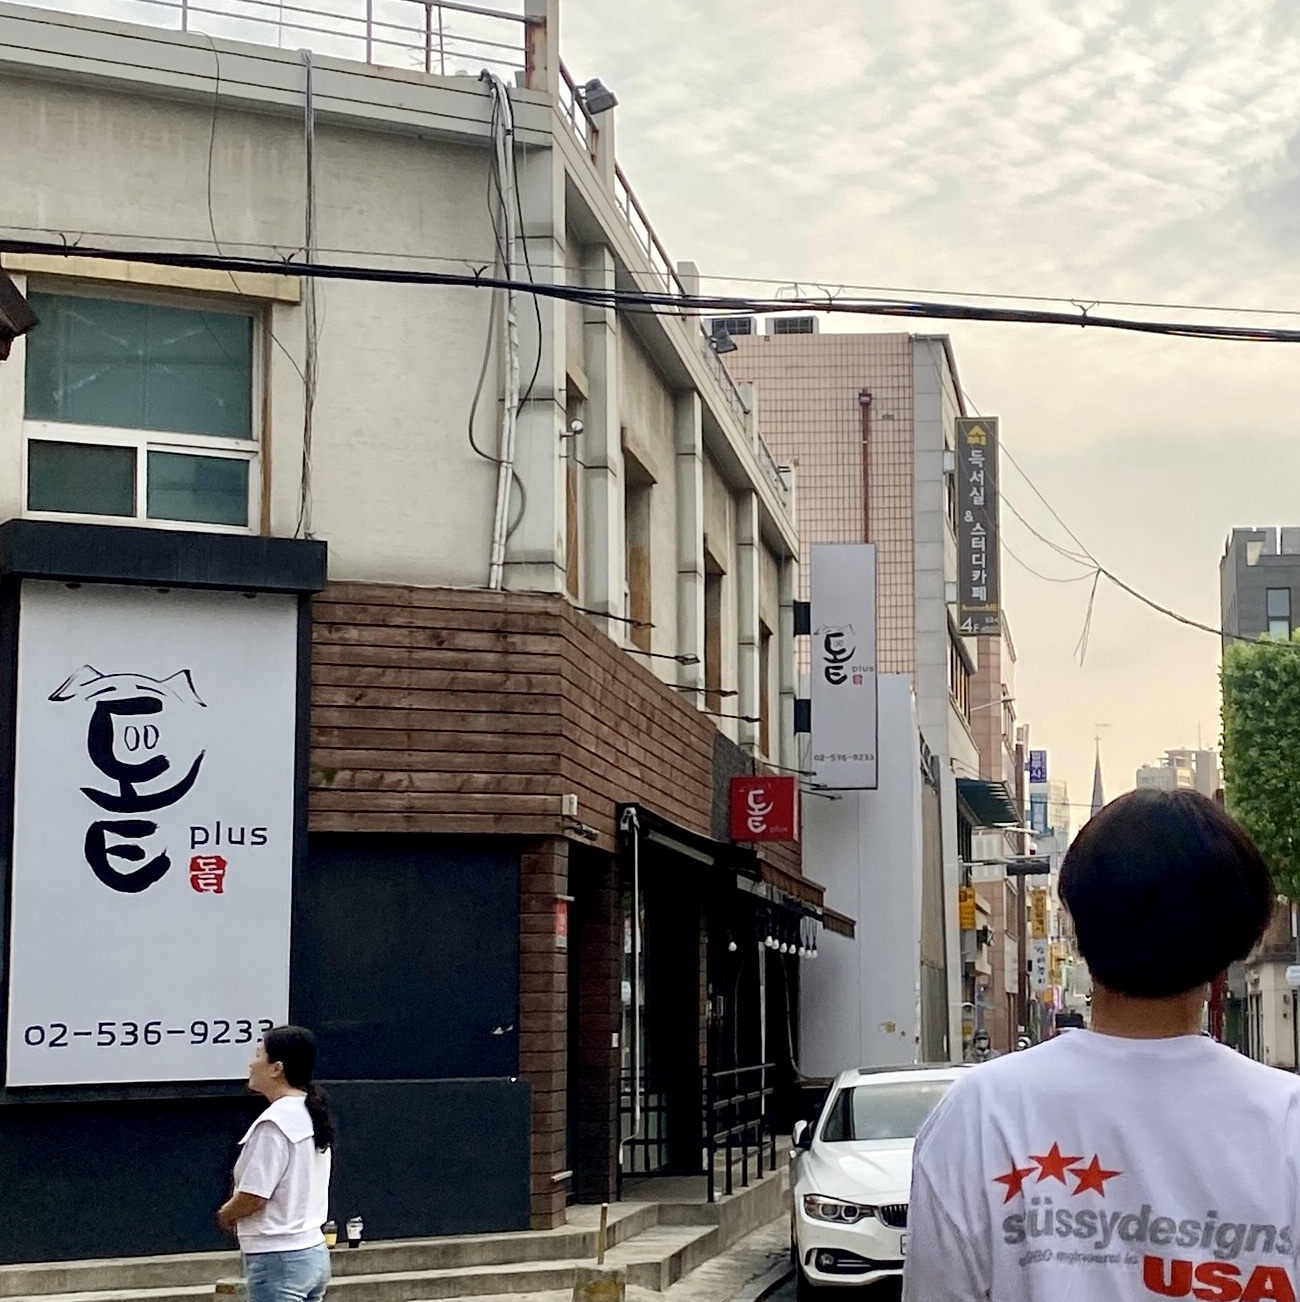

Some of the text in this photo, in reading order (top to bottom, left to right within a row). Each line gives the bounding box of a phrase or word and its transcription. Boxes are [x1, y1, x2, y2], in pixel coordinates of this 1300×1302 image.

[967, 448, 986, 506] 독서실
[963, 509, 974, 523] &
[970, 521, 988, 602] 스터디카페
[190, 820, 268, 850] plus
[1002, 1196, 1294, 1260] süssydesigns
